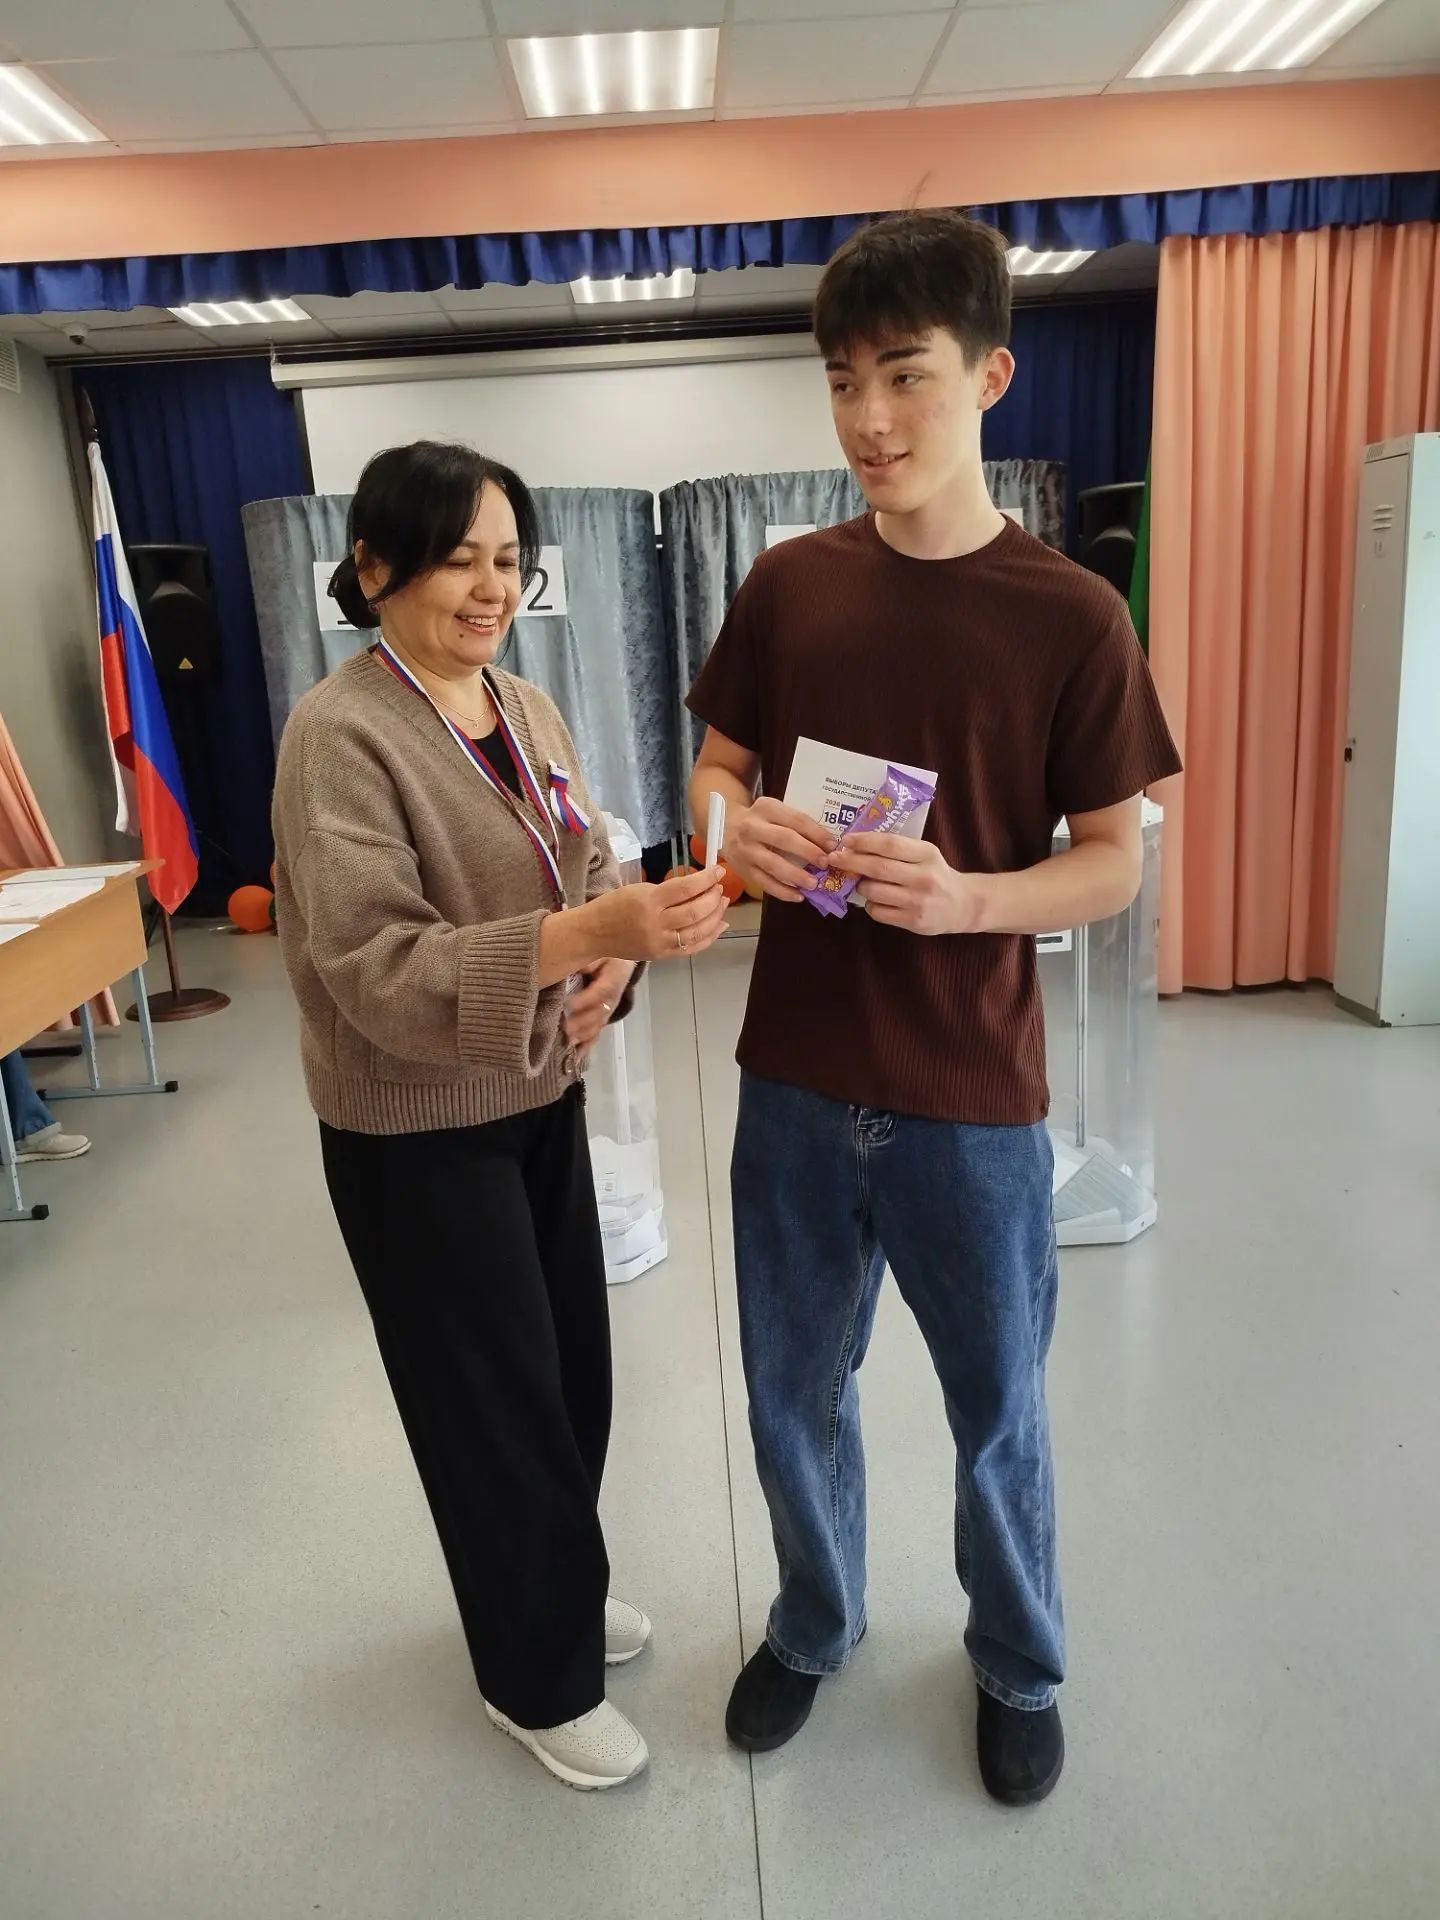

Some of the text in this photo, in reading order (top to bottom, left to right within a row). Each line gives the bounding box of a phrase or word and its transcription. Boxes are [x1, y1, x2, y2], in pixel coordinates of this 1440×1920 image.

[527, 566, 553, 611] 2
[825, 777, 852, 788] ВЫБОРЫ
[824, 809, 855, 825] 18 19
